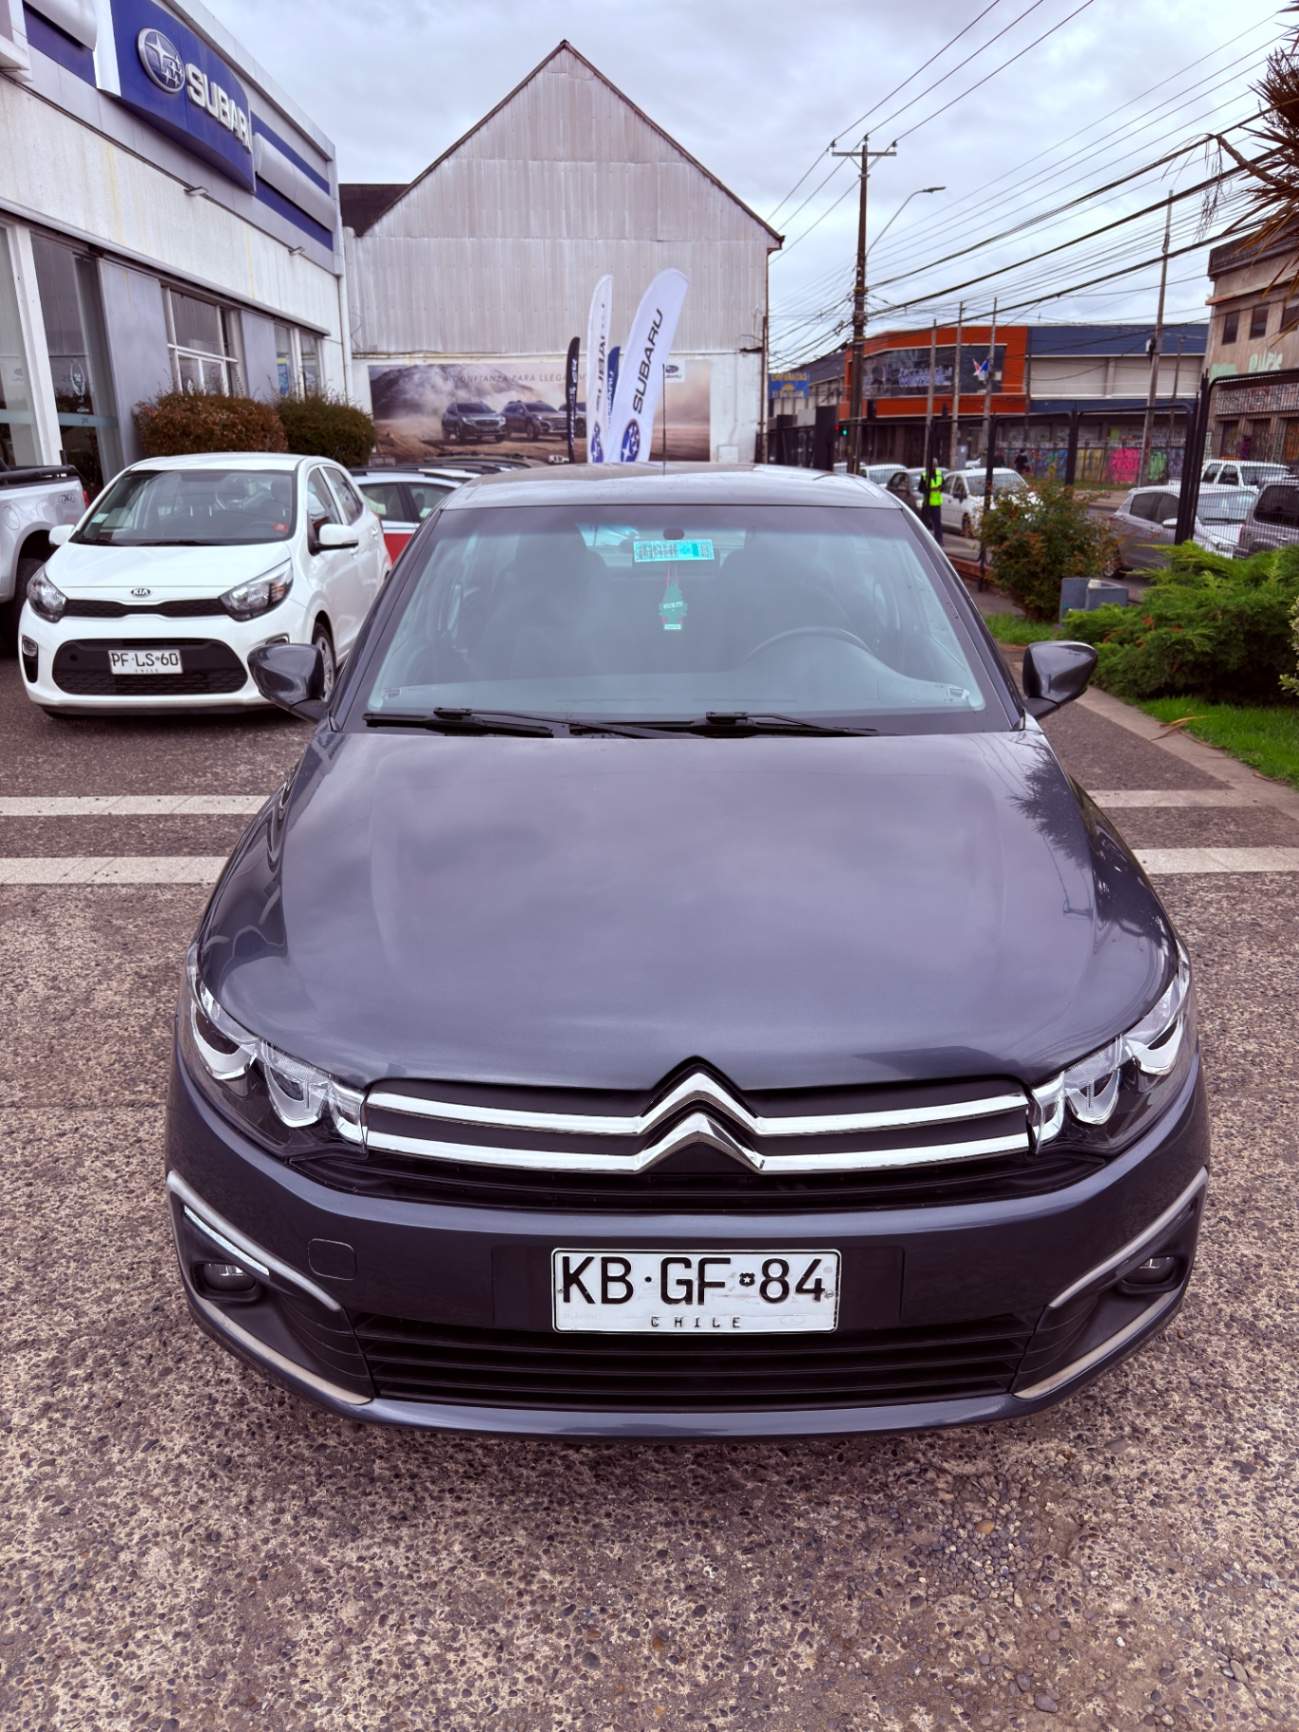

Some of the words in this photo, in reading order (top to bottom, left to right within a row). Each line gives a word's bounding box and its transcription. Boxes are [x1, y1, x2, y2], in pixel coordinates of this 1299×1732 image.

[186, 63, 252, 153] SUBAR
[632, 307, 664, 414] SUBARU
[132, 588, 150, 597] KIA
[650, 1316, 741, 1329] CHILE
